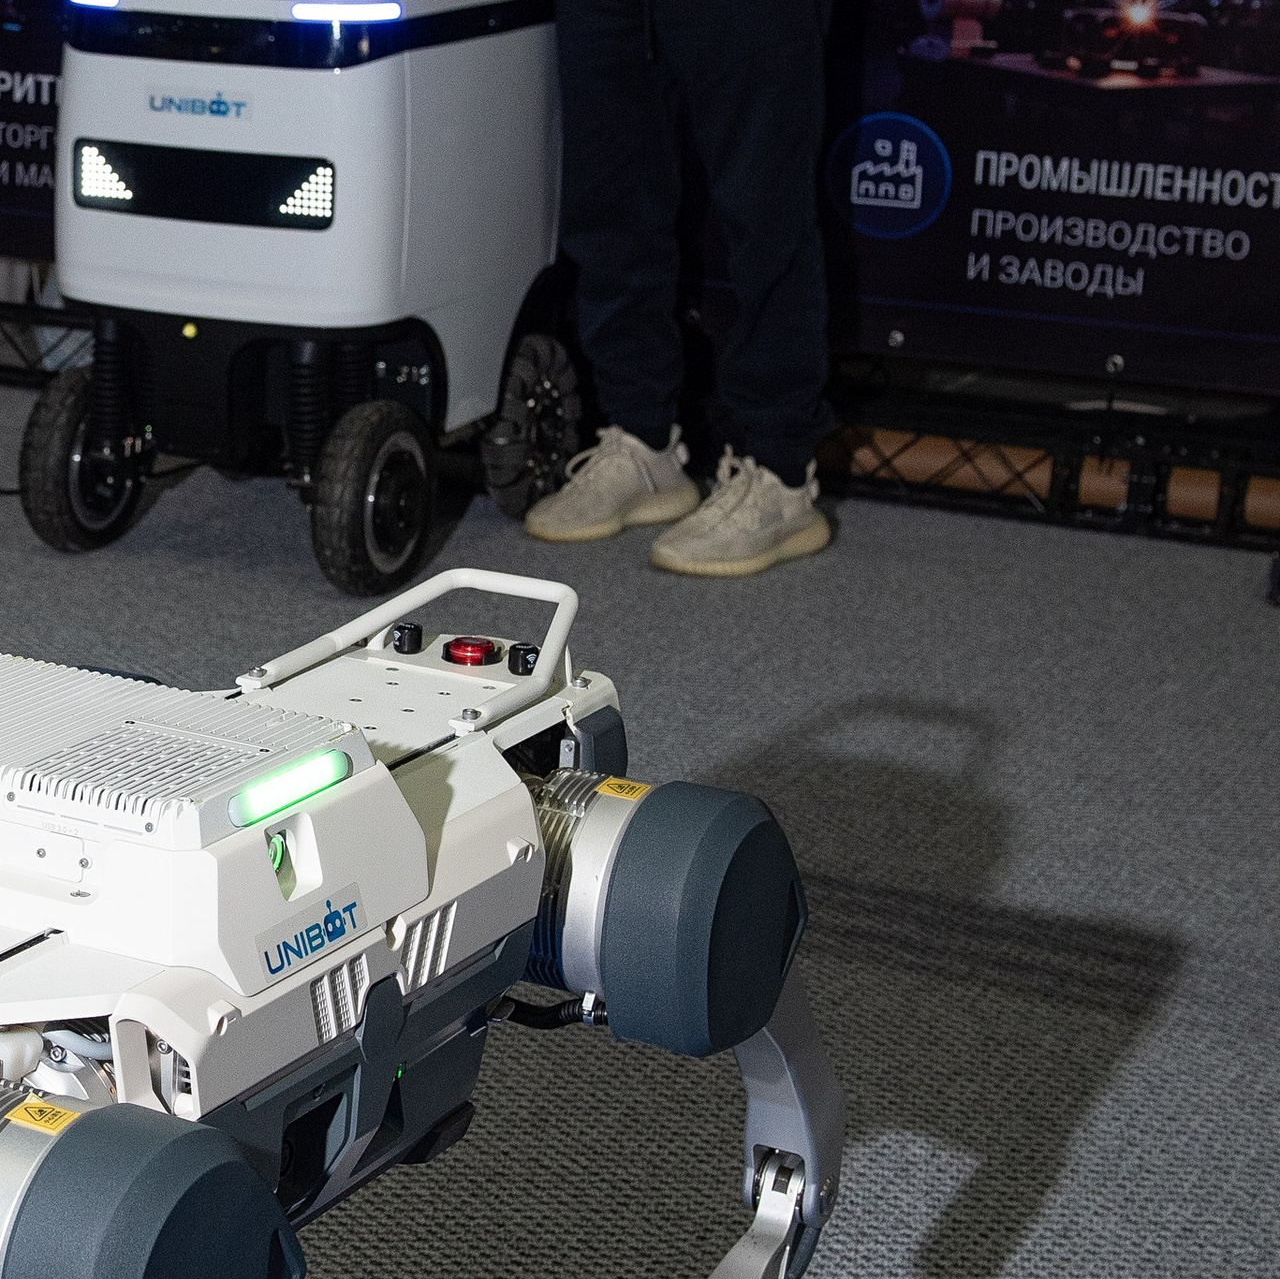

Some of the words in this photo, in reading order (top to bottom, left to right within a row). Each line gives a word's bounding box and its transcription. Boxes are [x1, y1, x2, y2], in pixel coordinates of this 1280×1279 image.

[149, 91, 247, 118] UNIBOT
[969, 207, 1251, 260] ПРОИЗВОДСТВО
[966, 252, 991, 281] И
[998, 254, 1145, 299] ЗАВОДЫ
[264, 899, 357, 975] UNIBOT
